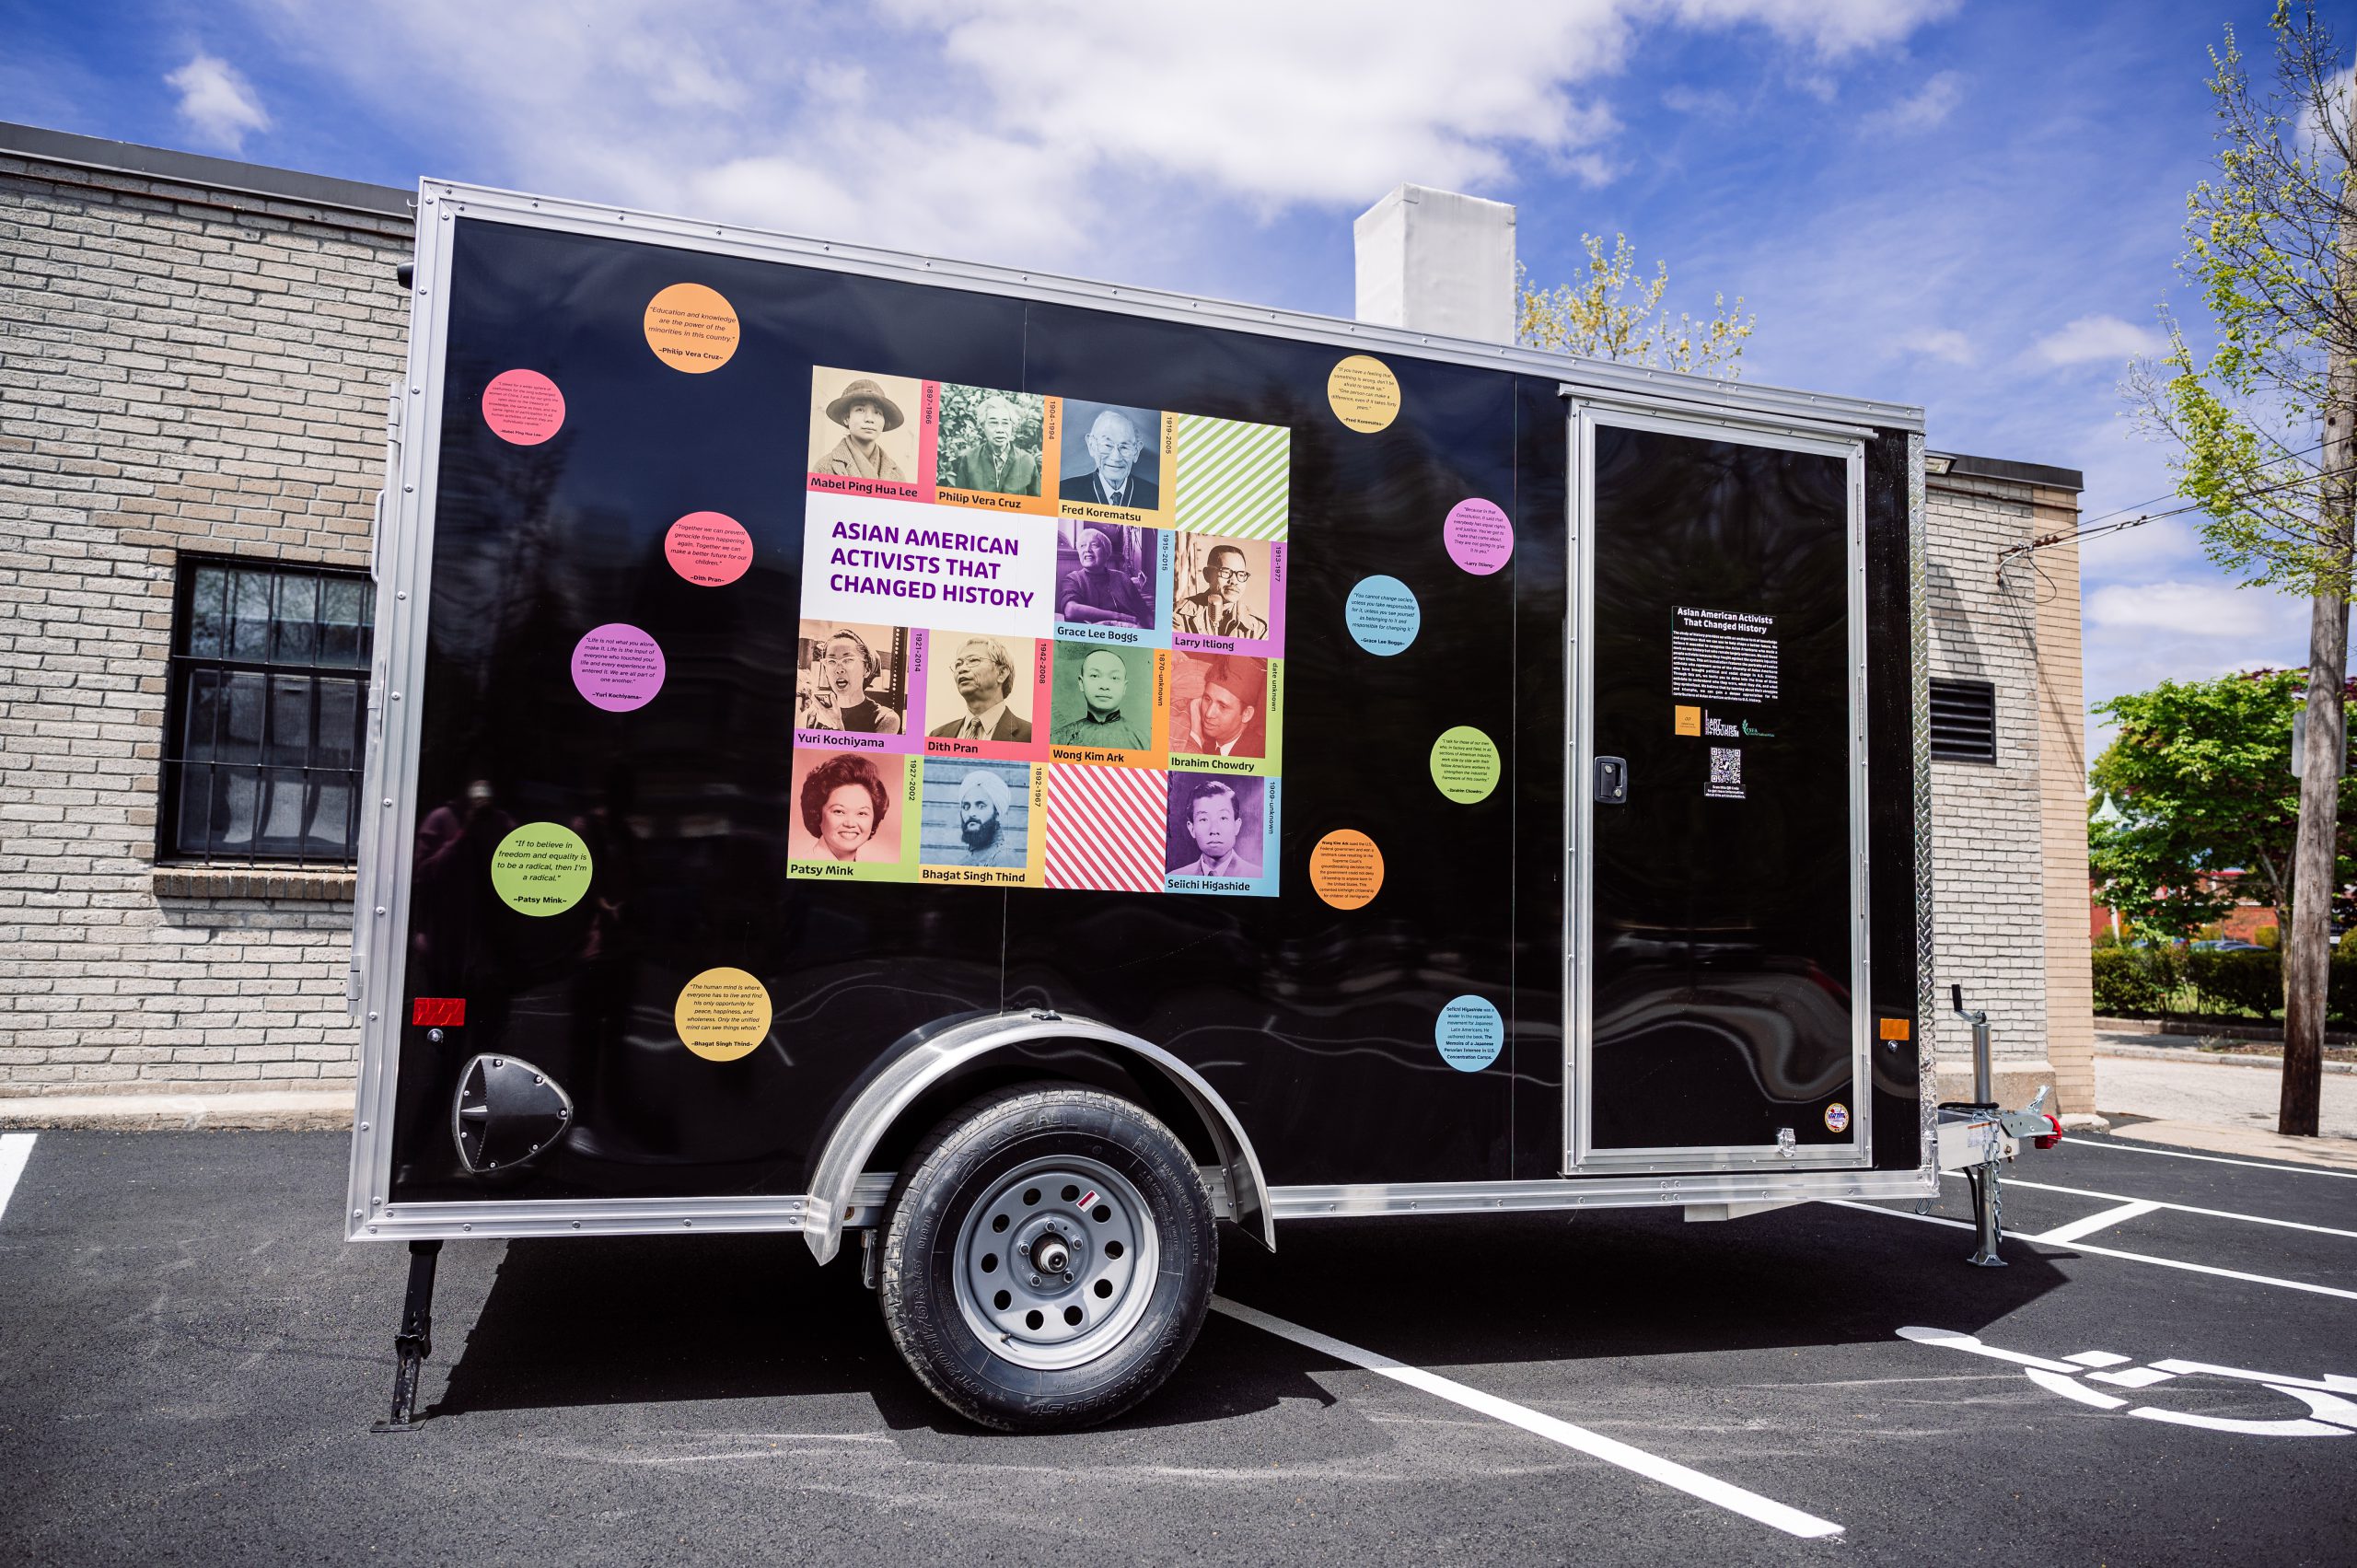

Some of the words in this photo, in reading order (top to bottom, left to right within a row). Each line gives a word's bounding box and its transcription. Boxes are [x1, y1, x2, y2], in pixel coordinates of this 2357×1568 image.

[684, 321, 703, 330] power
[702, 313, 736, 323] knowledge
[648, 327, 682, 336] minorities
[925, 386, 934, 424] 1897-1966
[811, 478, 845, 490] Mabel
[849, 482, 873, 494] Ping
[876, 484, 897, 495] Hua
[900, 487, 918, 497] Lee
[939, 492, 969, 505] Philip
[972, 495, 995, 506] Vera
[999, 498, 1021, 508] Cruz
[1062, 505, 1084, 516] Fred
[1086, 506, 1141, 522] Korematsu
[832, 522, 899, 543] ASIAN
[905, 528, 1018, 555] AMERICAN
[830, 548, 940, 575] ACTIVISTS
[946, 558, 1001, 579] THAT
[830, 575, 936, 599] CHANGED
[943, 585, 1034, 608] HISTORY
[1678, 608, 1699, 616] Asian
[1701, 610, 1737, 621] American
[1739, 614, 1772, 624] Activists
[1684, 618, 1701, 626] That
[1703, 620, 1736, 631] Changed
[1738, 623, 1767, 634] History
[1058, 626, 1086, 637] Grace
[1089, 629, 1105, 638] Lee
[1109, 631, 1138, 642] Boggs
[1175, 637, 1200, 648] Larry
[1203, 640, 1234, 651] Itliong
[797, 734, 820, 745] Yuri
[824, 735, 885, 748] Kochiyama
[928, 741, 950, 752] Dith
[954, 743, 979, 753] Pran
[1053, 749, 1082, 761] Wong
[1085, 751, 1104, 762] Kim
[1107, 753, 1123, 762] Ark
[1171, 757, 1209, 769] Ibrahim
[1212, 760, 1254, 772] Chowdry
[909, 760, 917, 801] 1927-2002
[791, 864, 822, 876] Patsy
[826, 865, 853, 876] Mink
[923, 869, 960, 880] Bhagat
[964, 871, 993, 881] Singh
[996, 872, 1025, 882] Thind
[1168, 879, 1199, 889] Seiichi
[1202, 881, 1250, 891] Higashide
